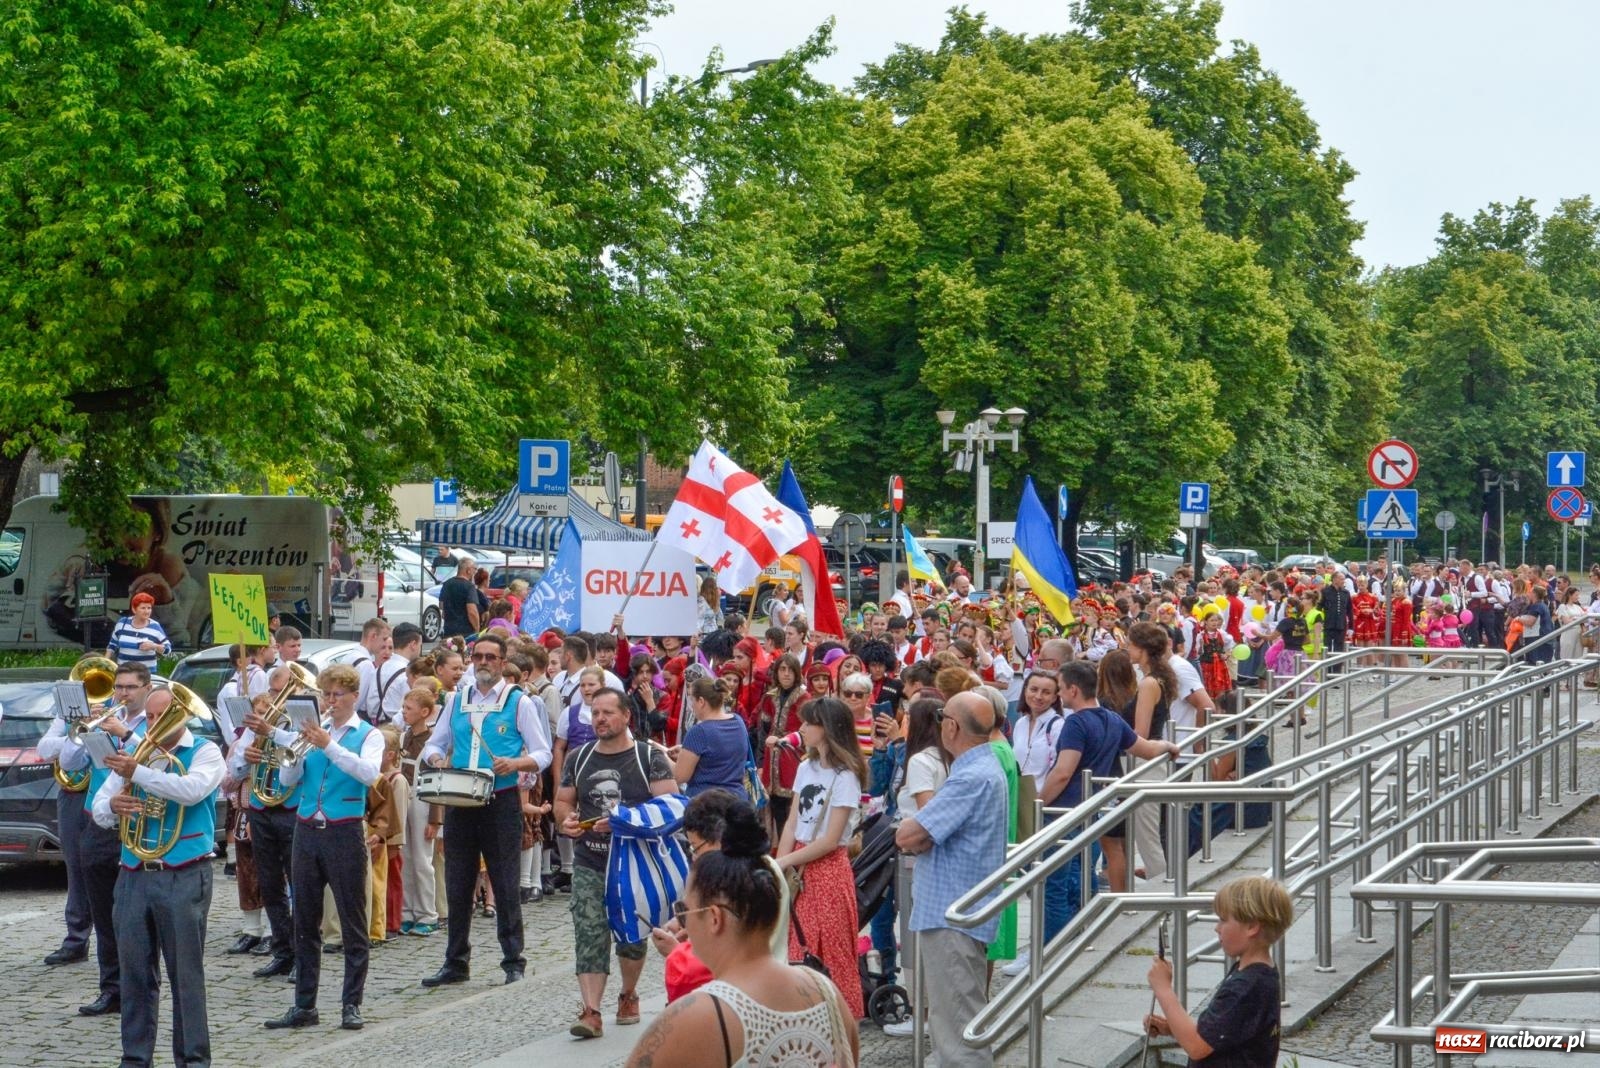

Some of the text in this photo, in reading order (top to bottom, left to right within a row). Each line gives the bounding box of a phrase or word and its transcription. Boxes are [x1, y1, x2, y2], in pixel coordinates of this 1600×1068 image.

[531, 446, 558, 487] P
[529, 502, 558, 510] Koniec
[1187, 486, 1204, 509] P
[171, 504, 248, 536] Świat
[182, 540, 308, 567] Prezentów
[585, 569, 689, 597] GRUZJA
